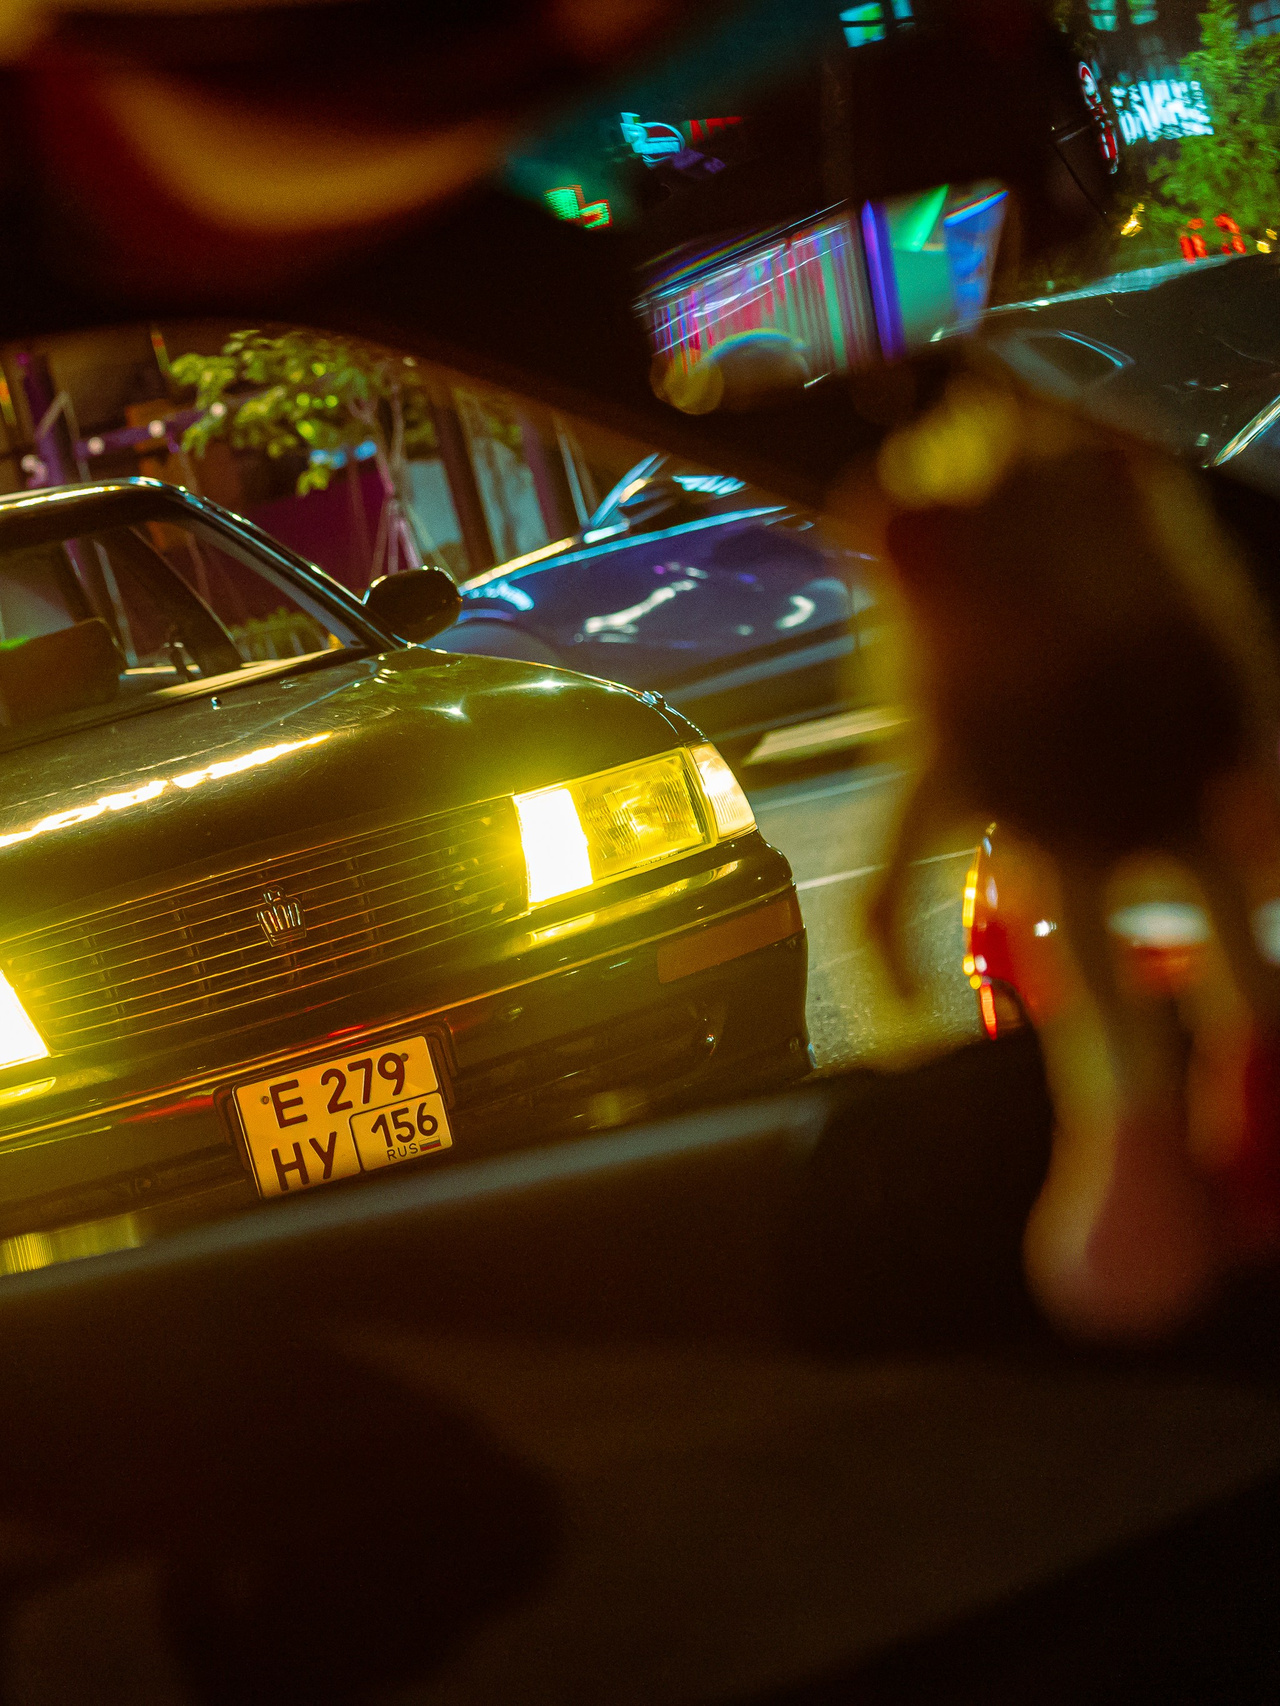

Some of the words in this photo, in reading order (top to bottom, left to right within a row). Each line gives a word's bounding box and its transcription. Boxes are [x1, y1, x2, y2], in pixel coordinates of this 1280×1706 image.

[269, 1079, 308, 1129] Е
[320, 1052, 406, 1114] 279
[370, 1102, 439, 1148] 156
[386, 1142, 419, 1161] RUS
[271, 1131, 337, 1192] НУ
